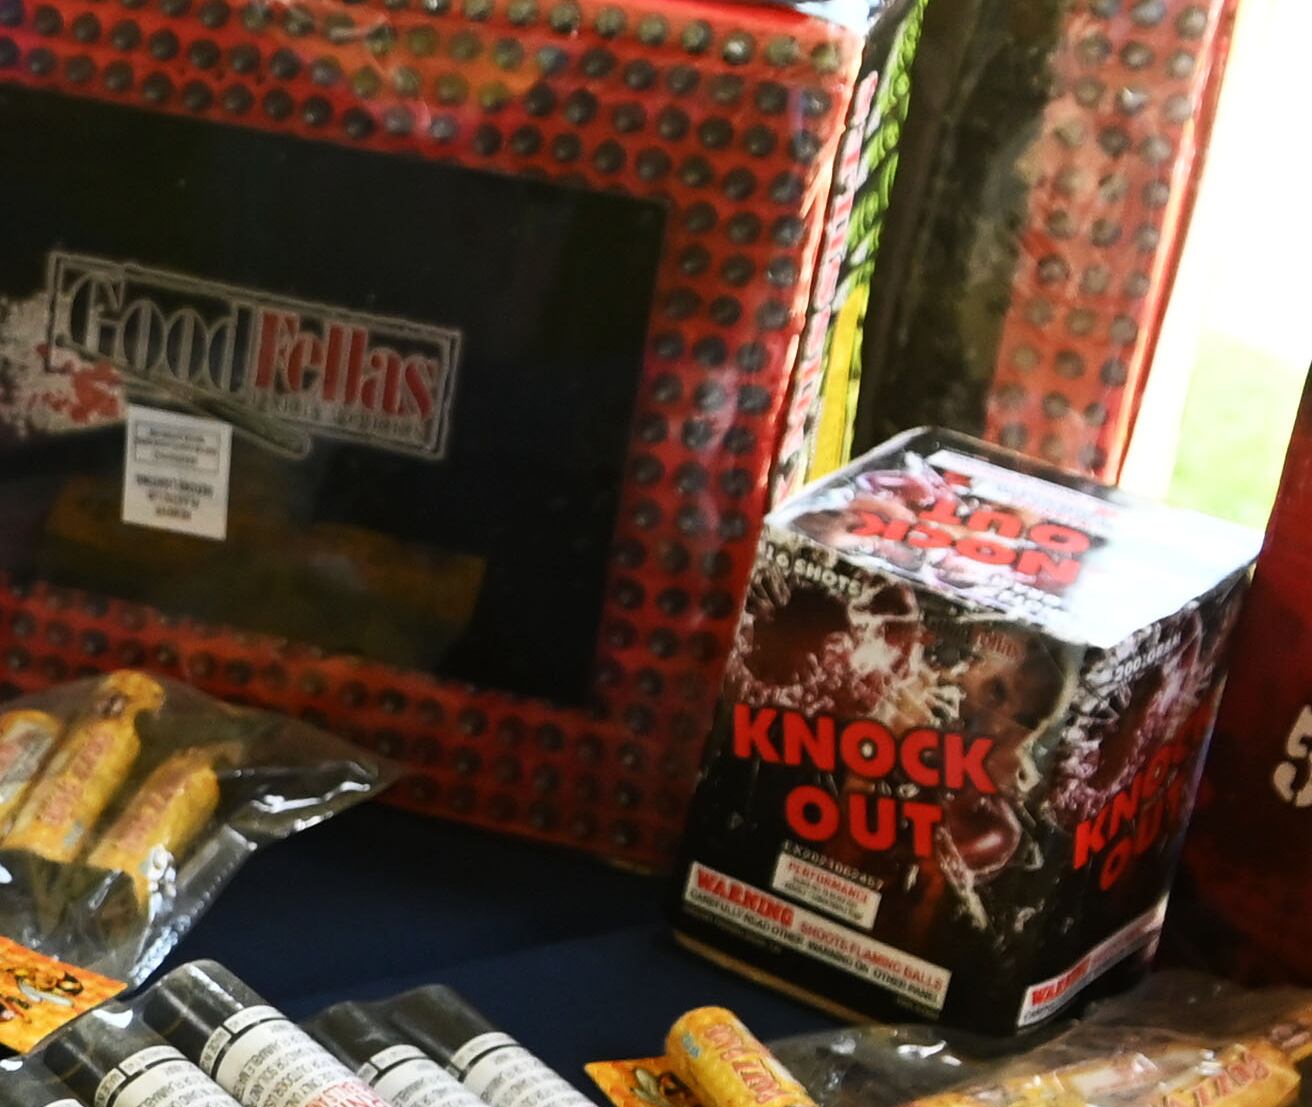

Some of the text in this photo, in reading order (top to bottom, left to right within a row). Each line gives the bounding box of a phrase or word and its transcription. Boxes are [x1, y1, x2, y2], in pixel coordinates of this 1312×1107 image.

[791, 553, 862, 598] SHOTS
[848, 506, 1082, 590] NOCK
[732, 703, 998, 796] KNOCK
[785, 786, 944, 858] OUT
[690, 868, 798, 928] WARNING
[902, 964, 945, 991] BALLS
